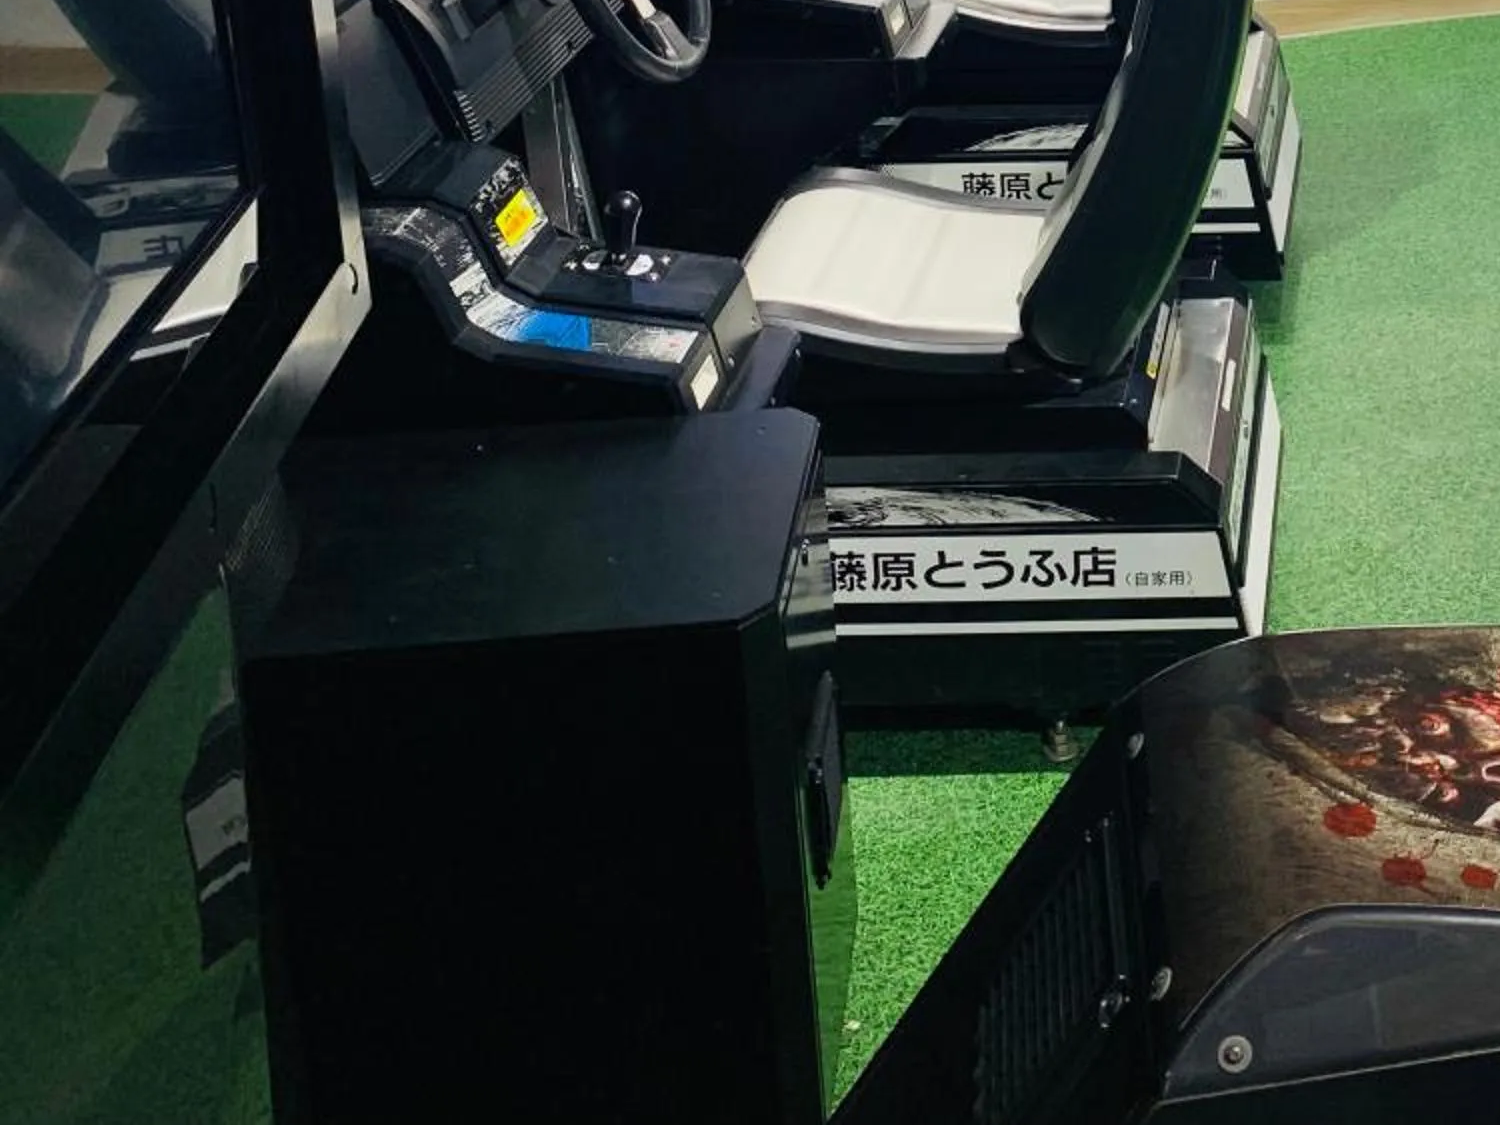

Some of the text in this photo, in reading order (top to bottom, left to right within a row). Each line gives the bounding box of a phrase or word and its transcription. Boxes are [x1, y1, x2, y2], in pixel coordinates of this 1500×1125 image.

[830, 546, 1117, 592] 藤原とうふ店
